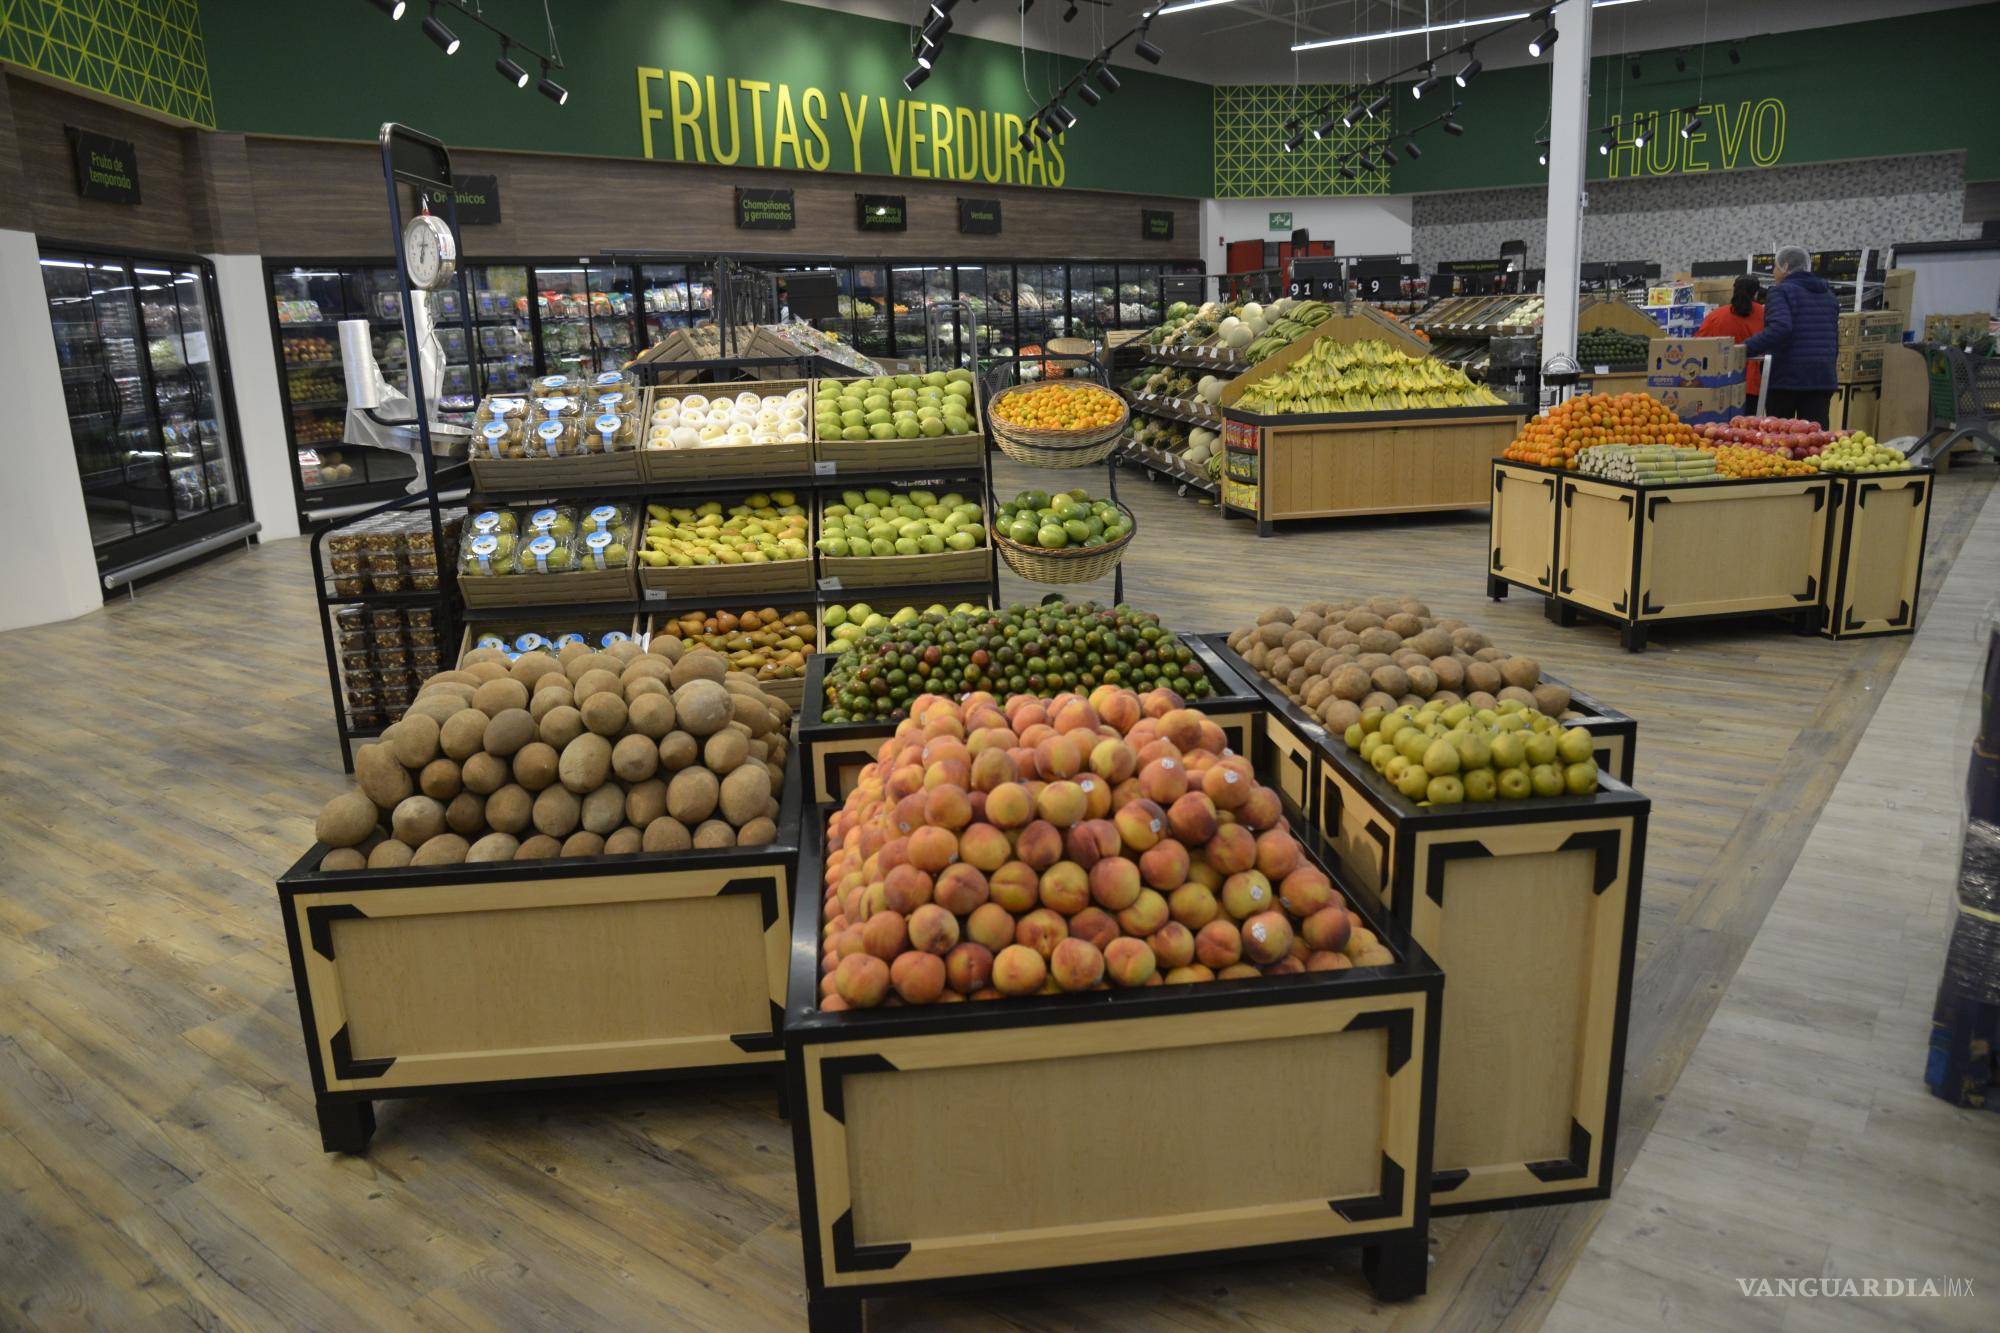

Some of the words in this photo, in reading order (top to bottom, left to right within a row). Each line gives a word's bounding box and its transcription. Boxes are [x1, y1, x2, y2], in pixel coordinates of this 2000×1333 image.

[637, 66, 830, 171] FRUTAS
[840, 91, 868, 173] Y
[879, 96, 1065, 187] VERDURAS
[1609, 98, 1786, 178] HUEVO
[91, 151, 112, 169] Fruta
[113, 157, 123, 172] de
[89, 167, 131, 189] temporada
[742, 199, 791, 211] Champiñones
[744, 212, 749, 222] y
[751, 210, 792, 221] germinados
